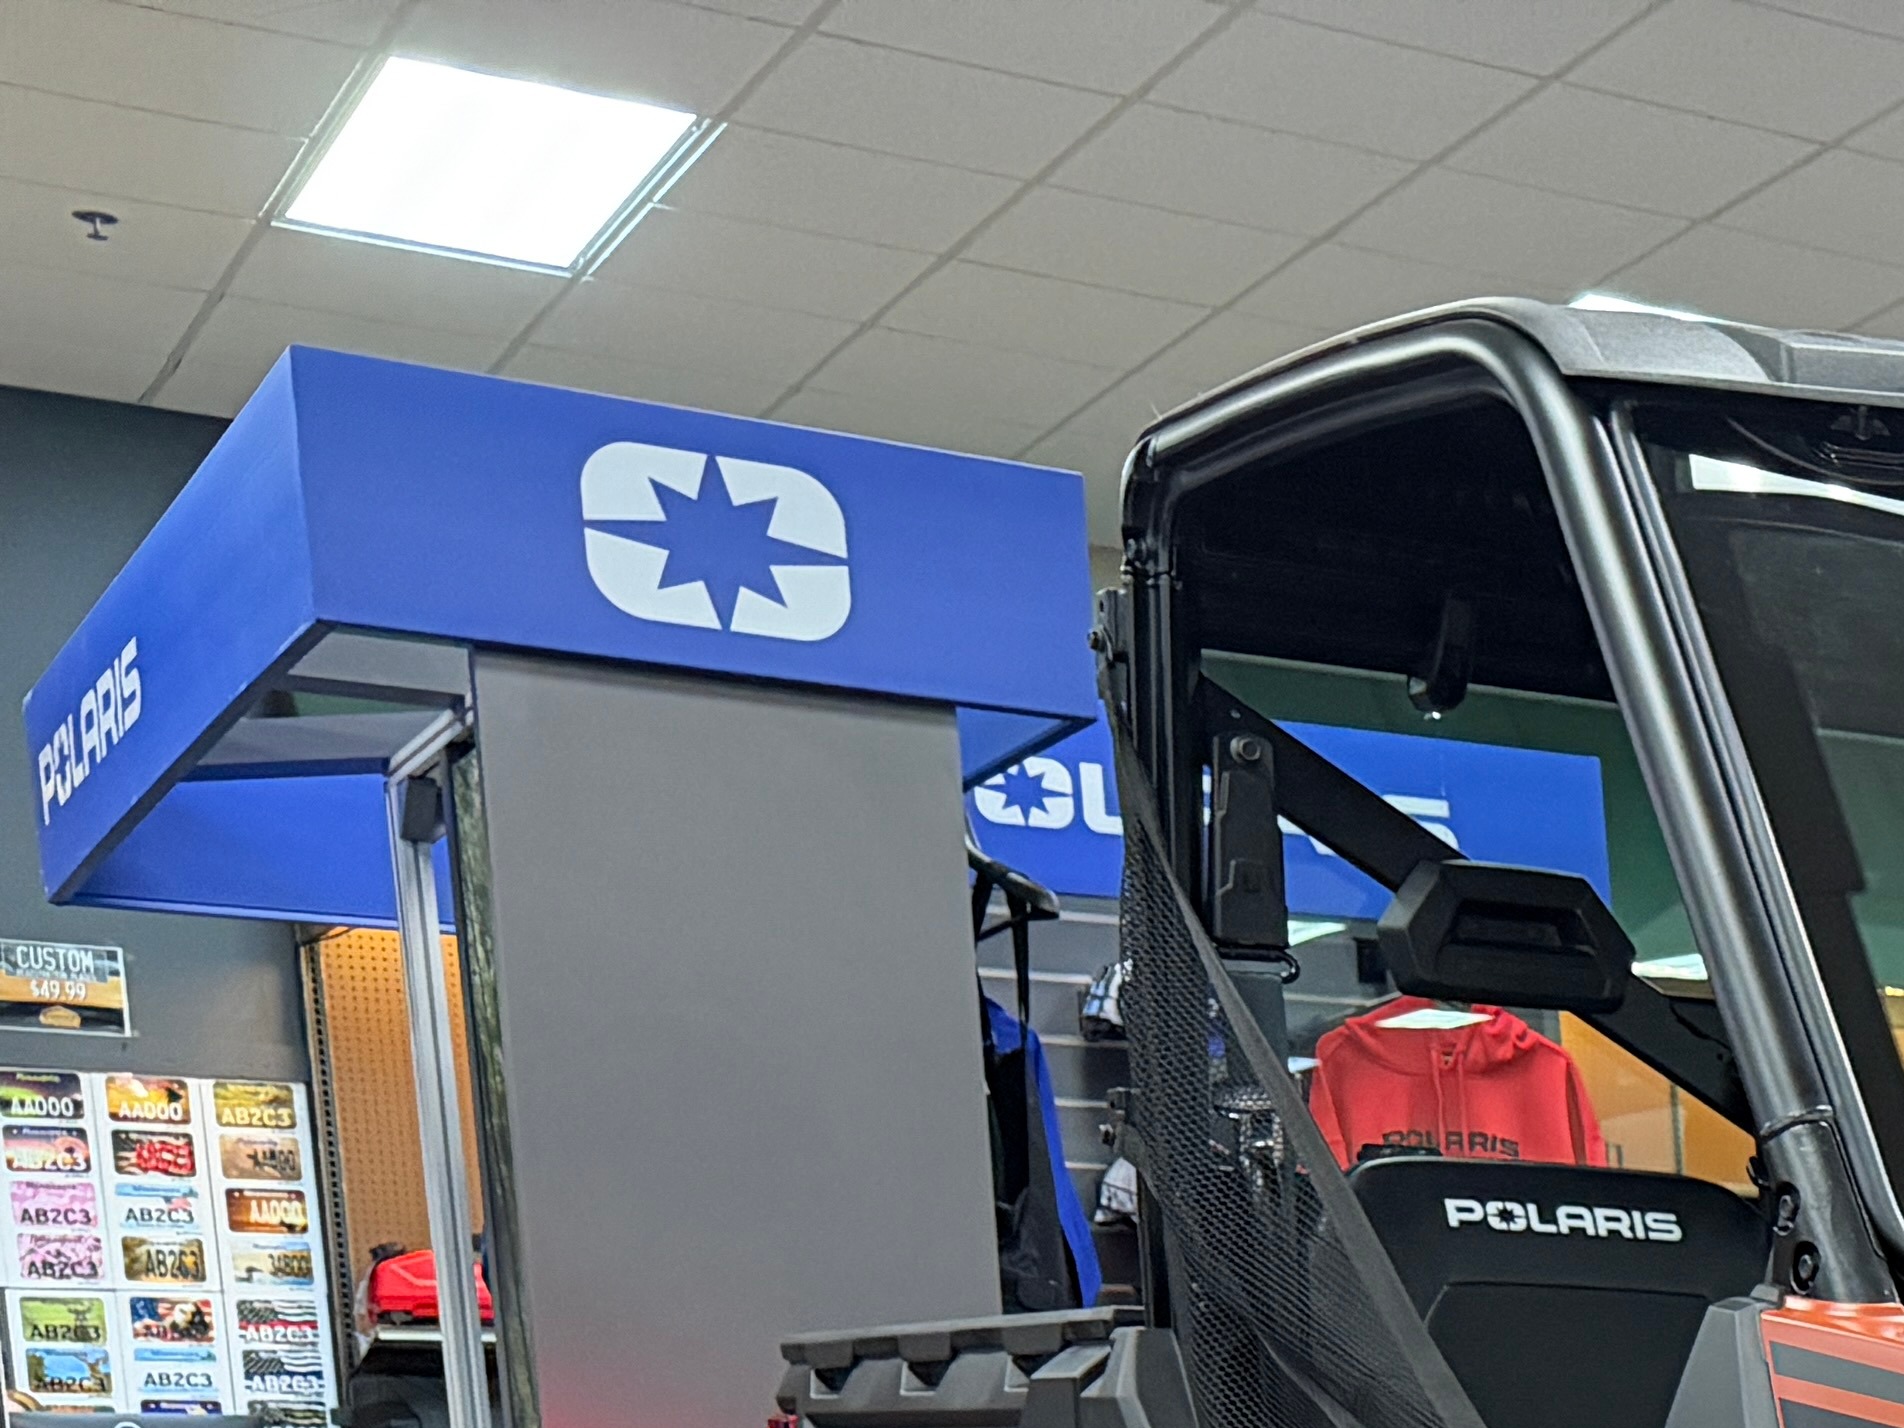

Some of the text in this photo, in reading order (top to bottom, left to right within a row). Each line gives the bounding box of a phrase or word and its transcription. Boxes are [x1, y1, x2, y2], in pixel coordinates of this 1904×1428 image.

[38, 636, 141, 826] POLARIS
[16, 946, 94, 973] CUSTOM
[30, 980, 86, 1000] $49.99
[222, 1107, 291, 1126] AB2C3
[1382, 1130, 1519, 1156] POLARIS
[20, 1207, 92, 1225] AB2C3
[125, 1207, 194, 1224] AB2C3
[1444, 1198, 1683, 1242] POLARIS
[27, 1260, 98, 1279] AB2C3
[30, 1324, 101, 1340] AB2C3
[246, 1325, 313, 1342] AB2C3
[144, 1372, 213, 1388] AB2C3
[251, 1374, 319, 1393] AB2C3
